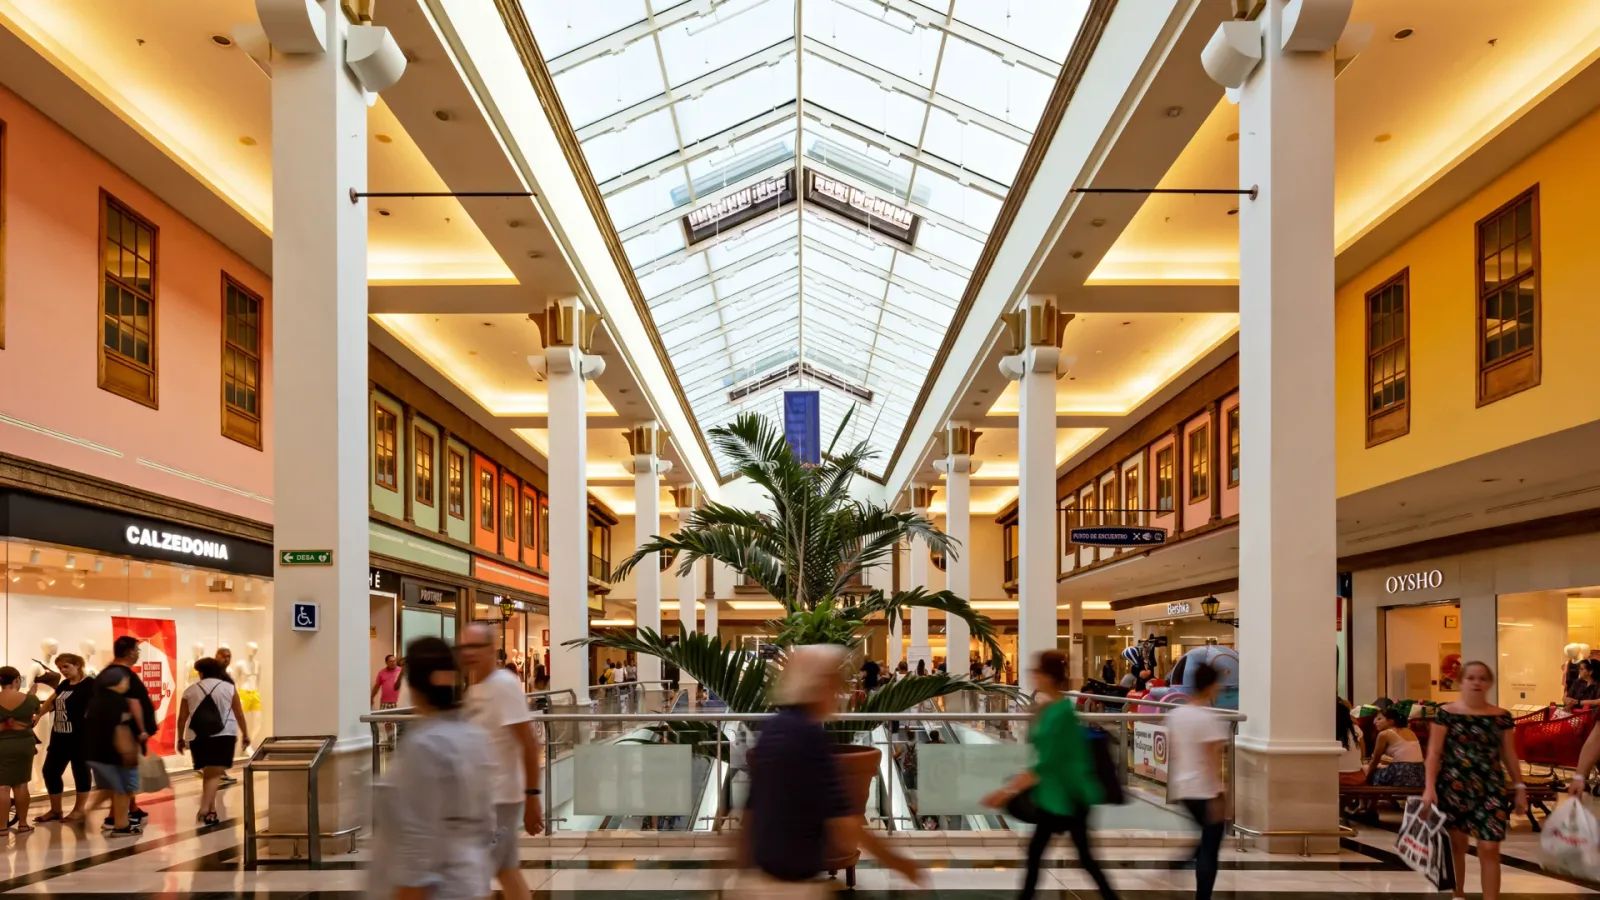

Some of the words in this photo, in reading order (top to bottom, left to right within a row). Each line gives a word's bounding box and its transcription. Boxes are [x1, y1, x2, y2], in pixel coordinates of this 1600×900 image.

[126, 525, 229, 561] CALZEDONIA
[1386, 569, 1443, 594] OYSHO
[1168, 602, 1190, 615] Bershka
